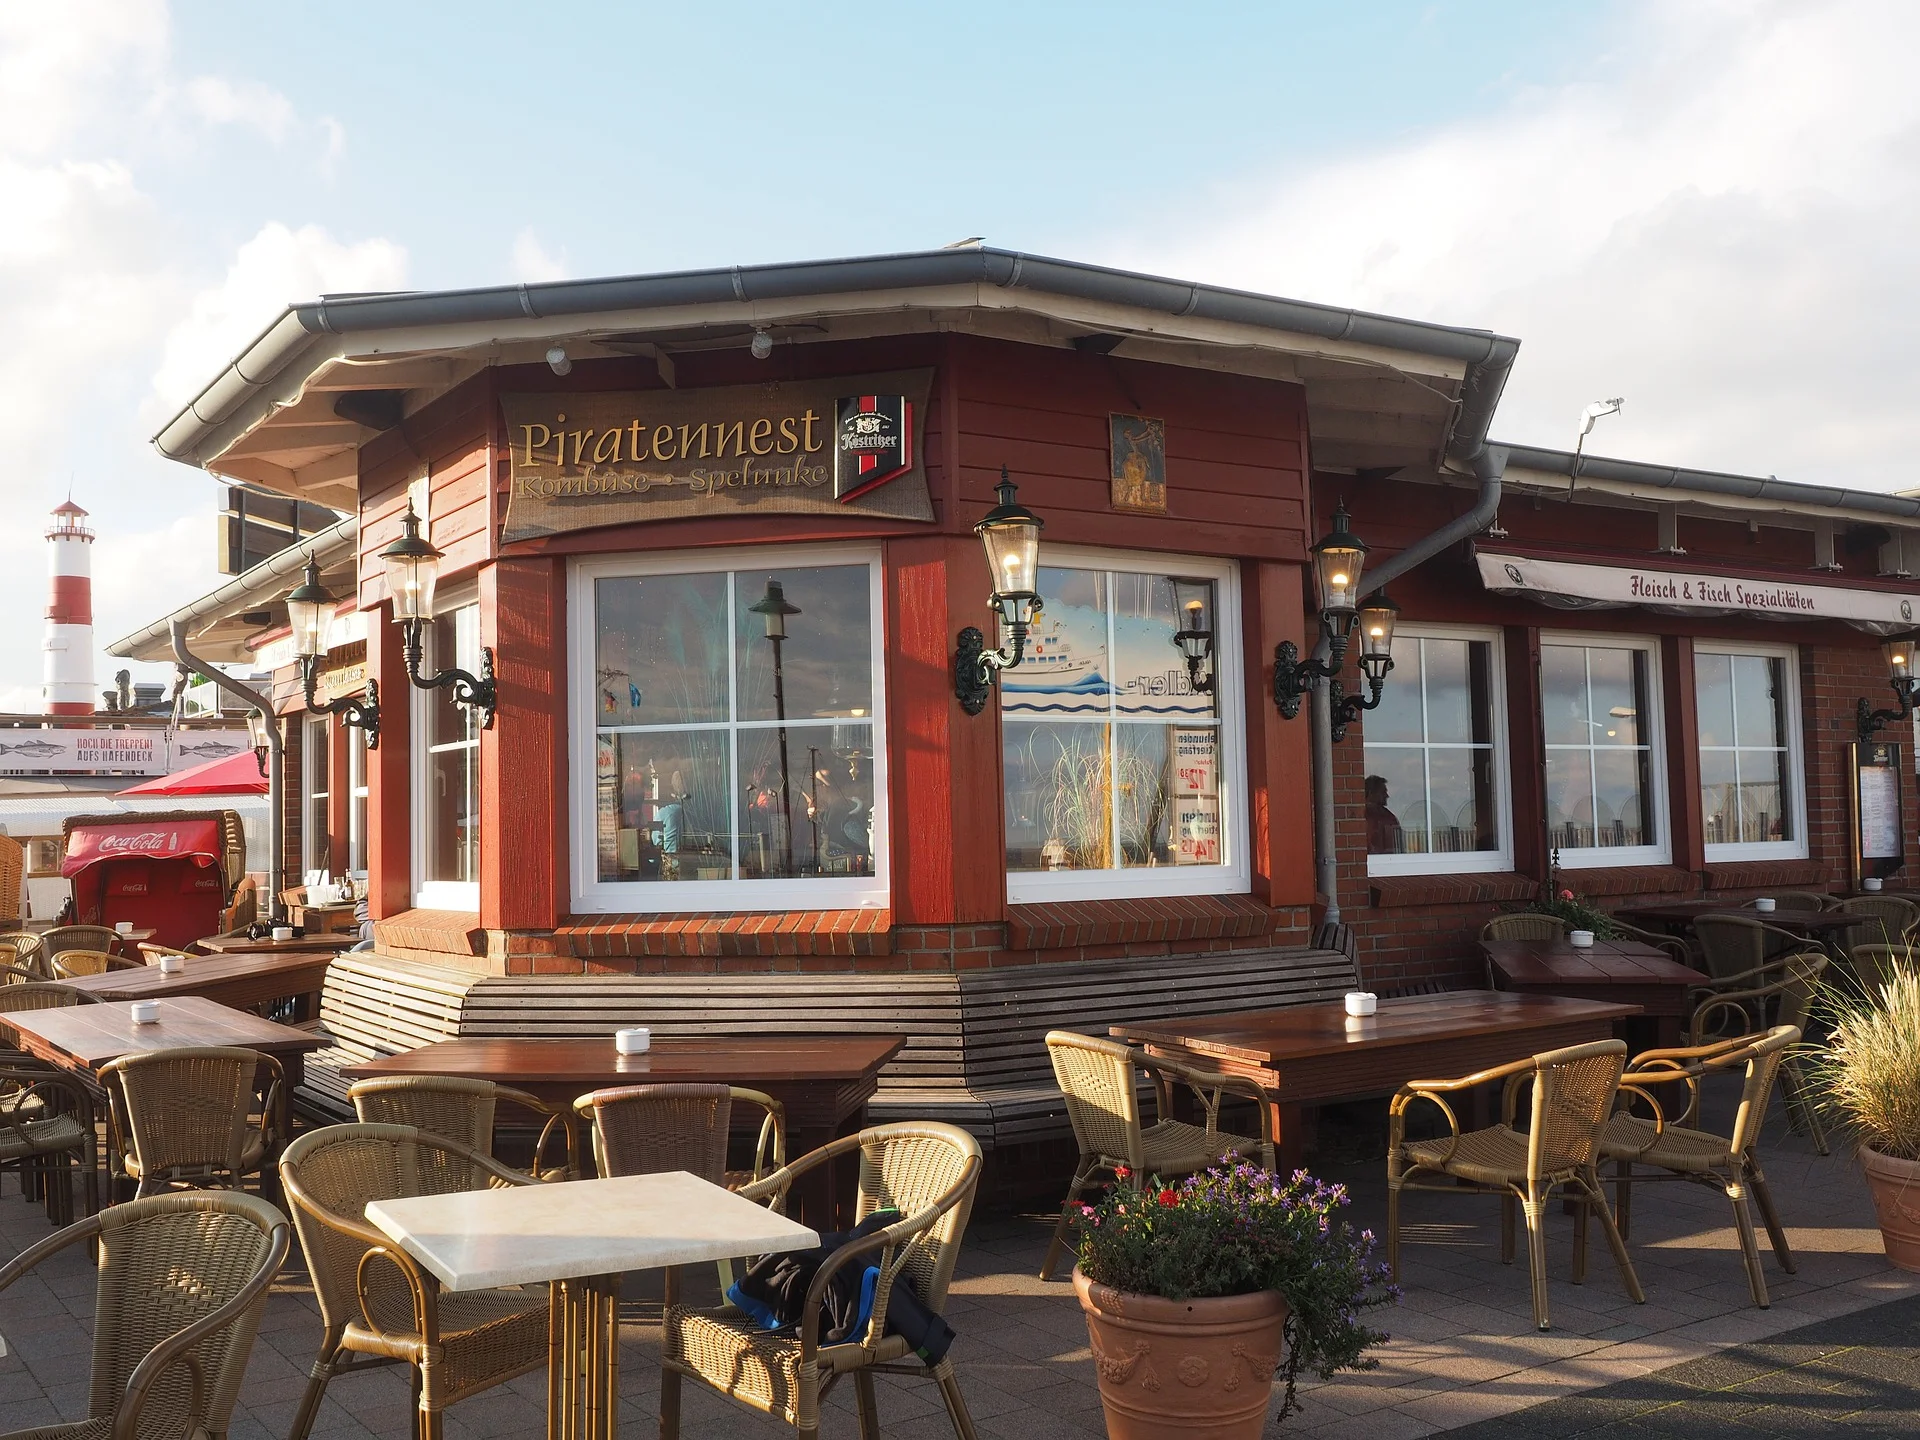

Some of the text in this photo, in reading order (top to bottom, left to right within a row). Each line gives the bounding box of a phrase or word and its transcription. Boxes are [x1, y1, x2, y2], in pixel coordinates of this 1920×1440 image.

[519, 409, 823, 467] Piratennest
[841, 432, 898, 451] Köstritzer
[520, 455, 827, 498] Kombüse Spelunke
[1629, 575, 1816, 610] Fleisch & Fisch Spezialitäten
[77, 738, 153, 750] HOCH DIE TREPPEN!
[77, 750, 153, 762] AUFS HAFENDECK
[99, 832, 168, 852] Coca-Cola
